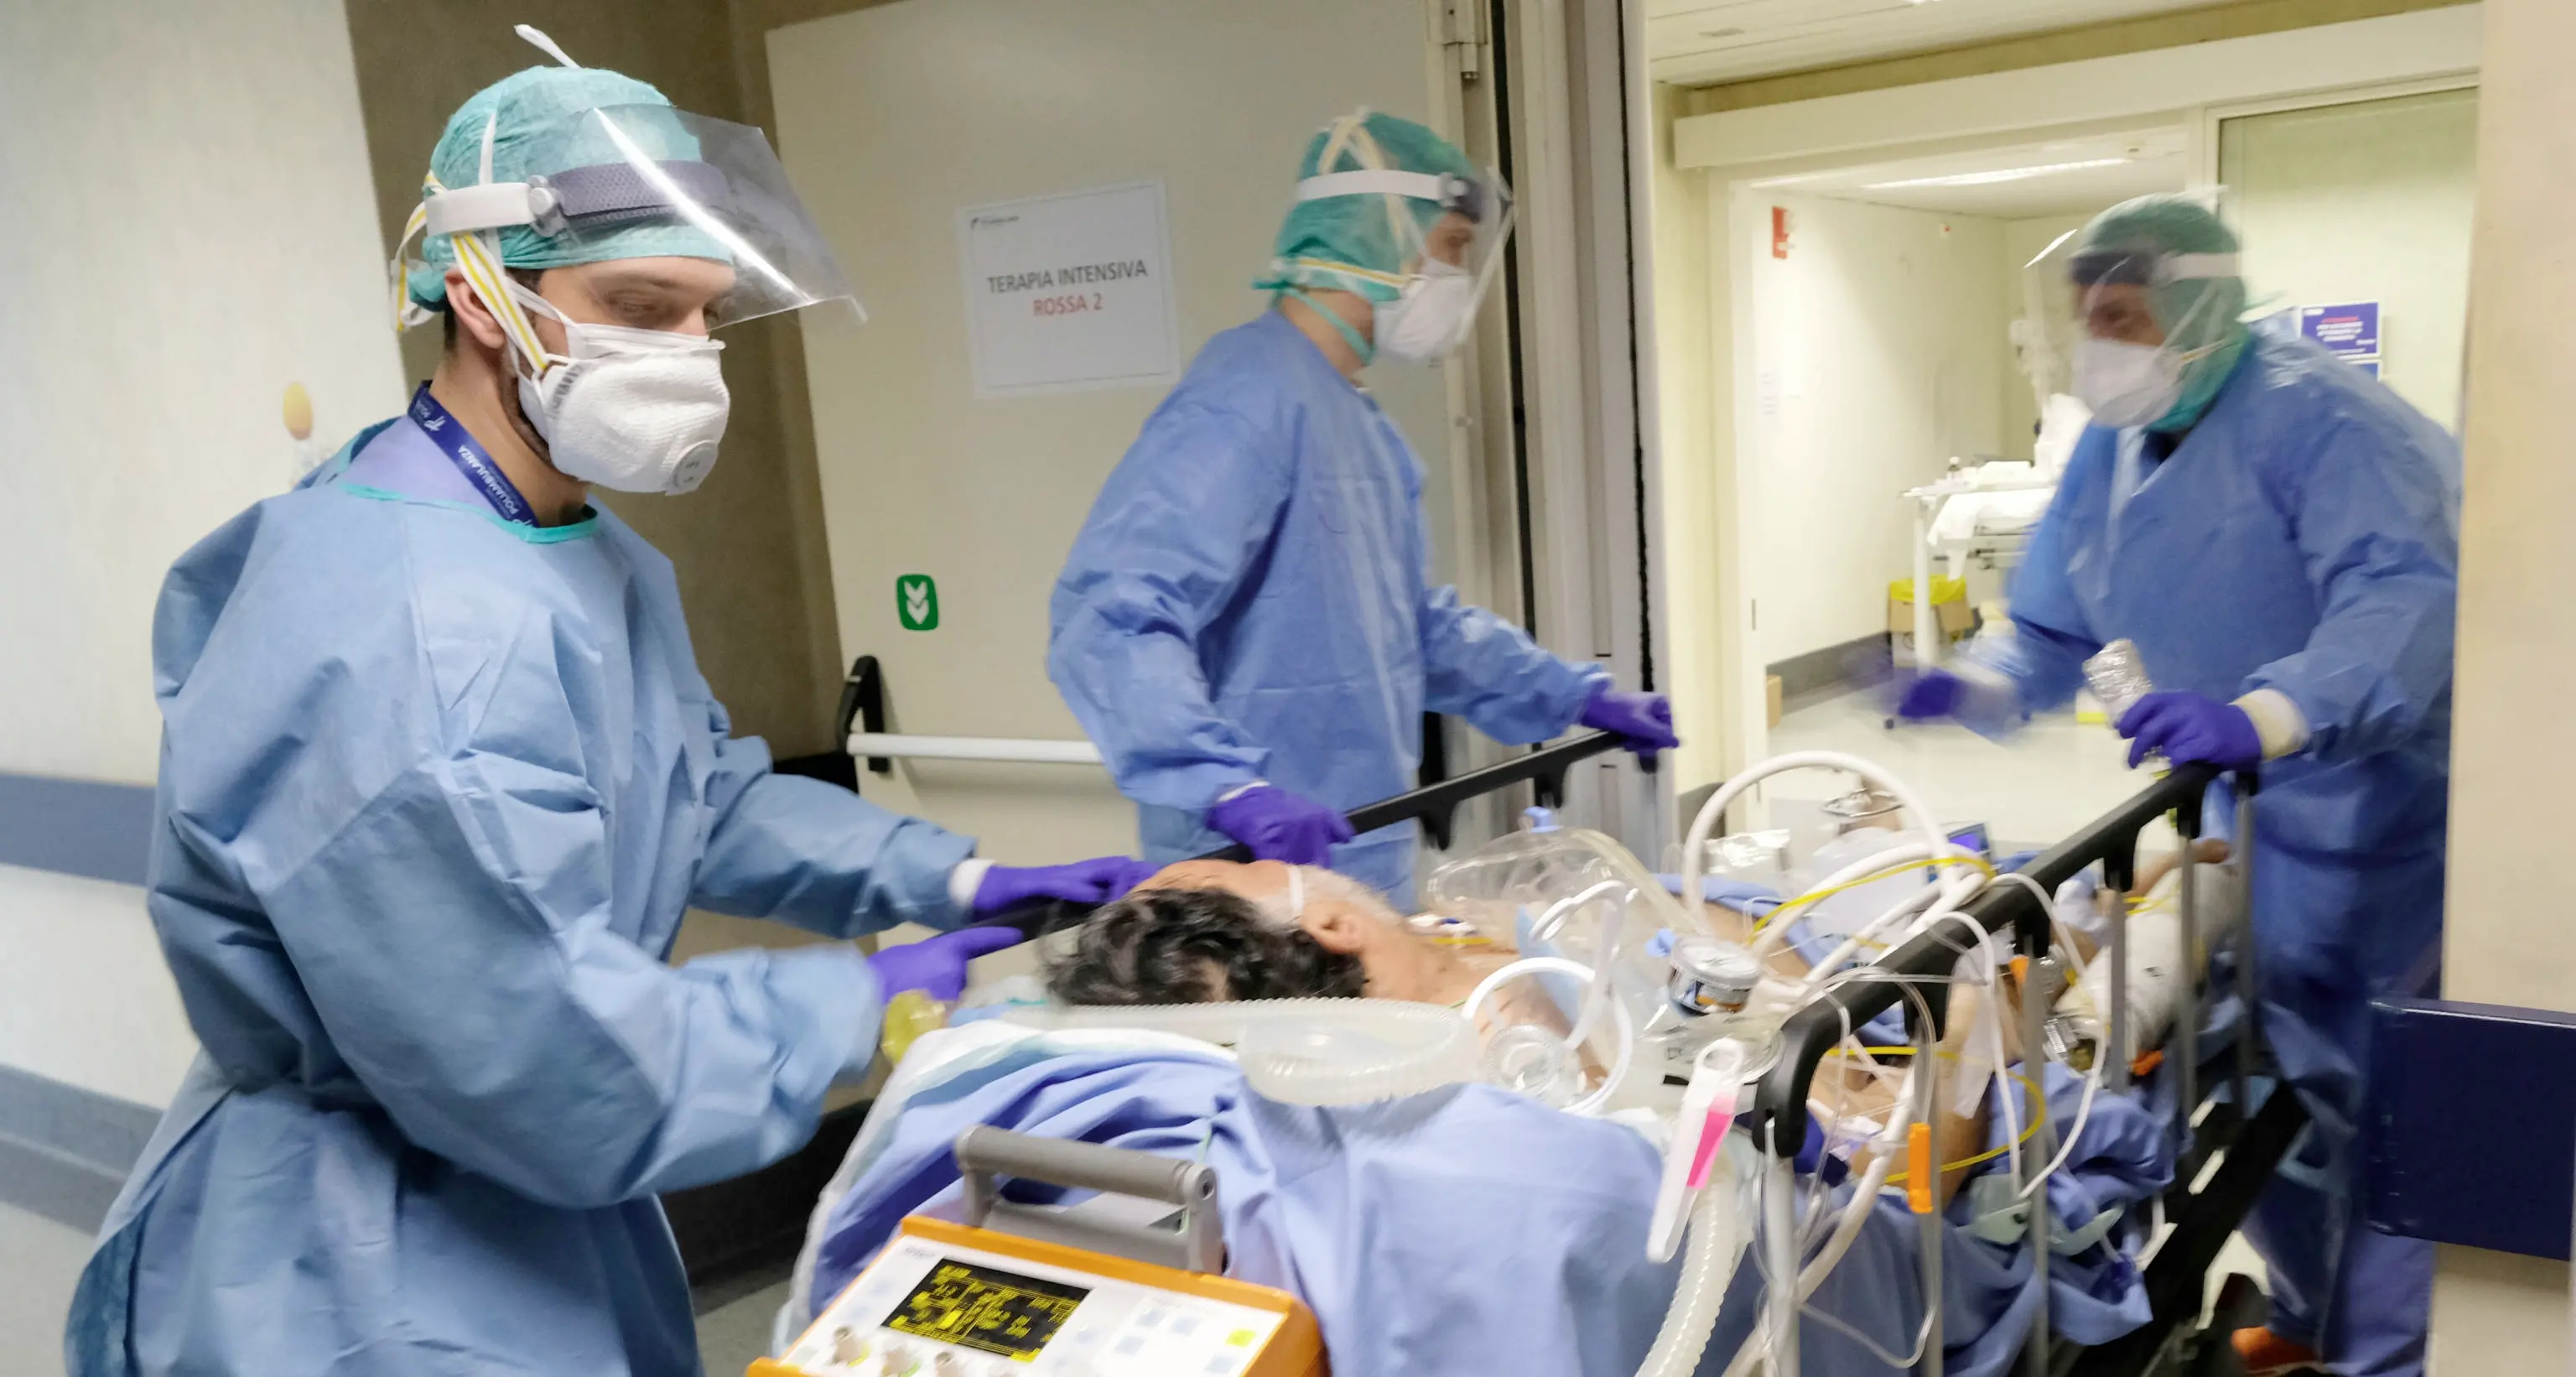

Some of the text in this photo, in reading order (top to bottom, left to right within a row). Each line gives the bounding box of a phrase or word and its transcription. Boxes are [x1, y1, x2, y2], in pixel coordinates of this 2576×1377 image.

[986, 259, 1148, 294] TERAPIA INTENSIVA
[1033, 293, 1104, 316] ROSSA 2
[458, 445, 519, 515] POLIAMBULANZA
